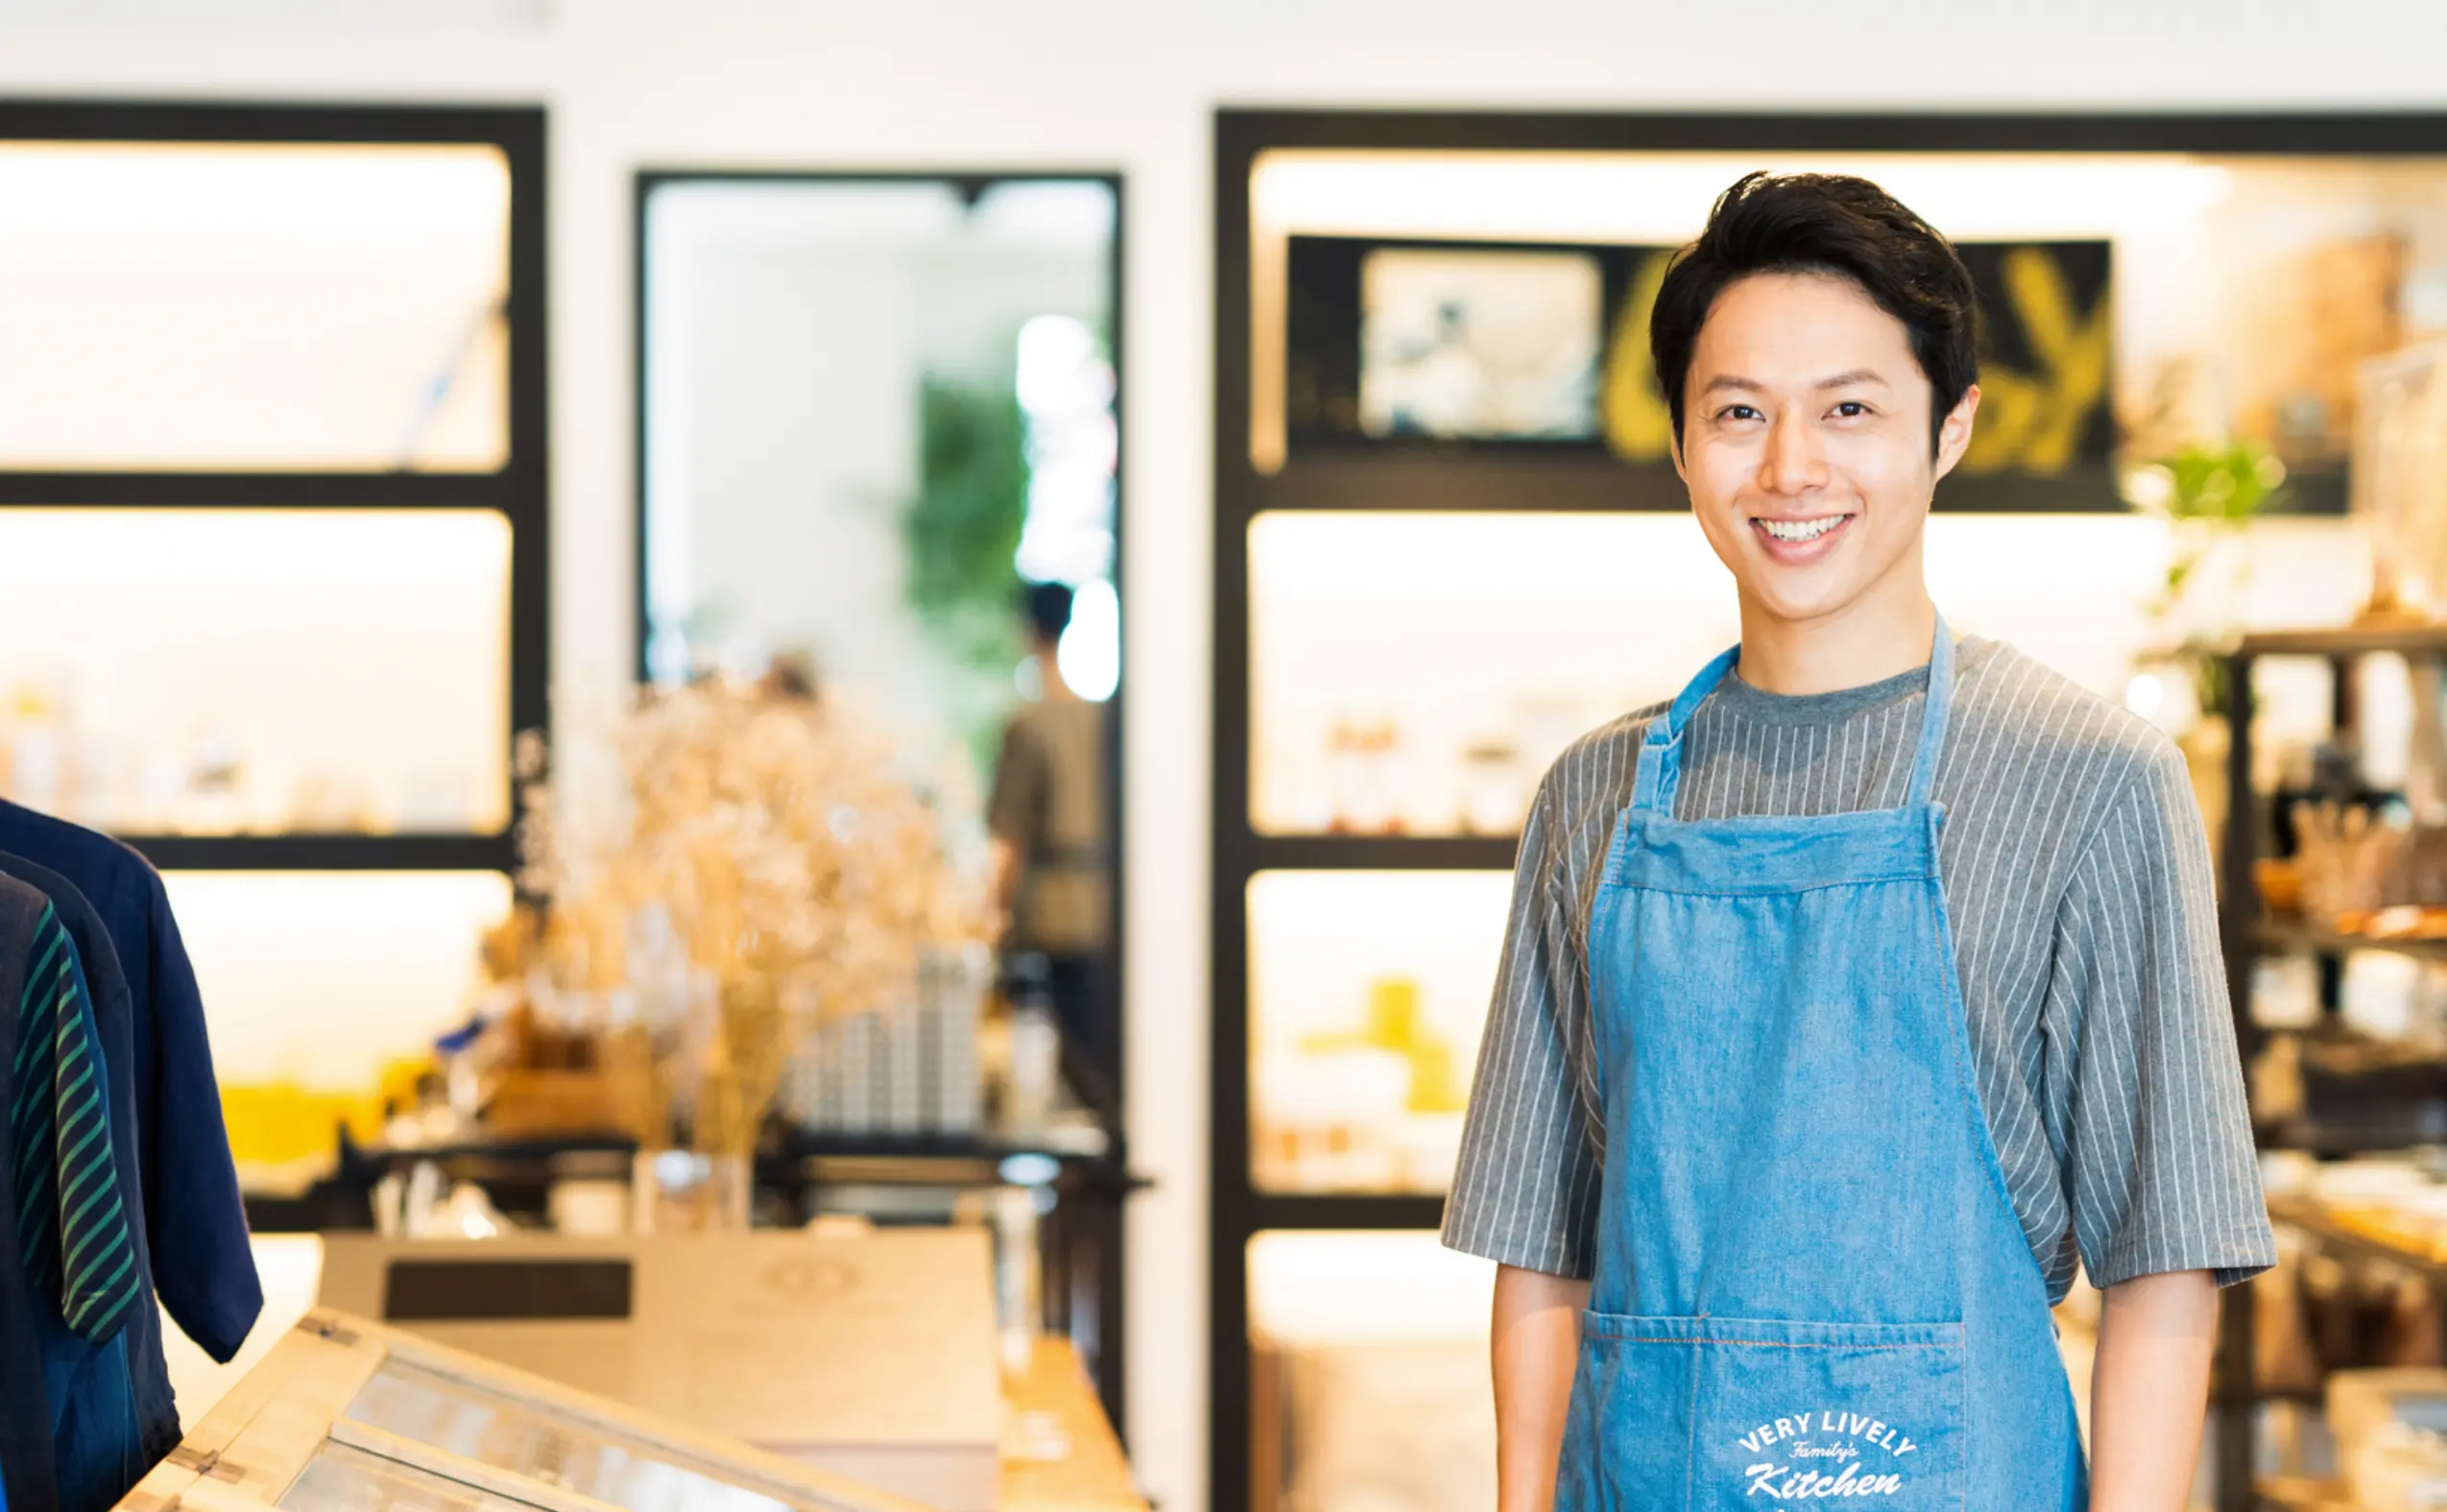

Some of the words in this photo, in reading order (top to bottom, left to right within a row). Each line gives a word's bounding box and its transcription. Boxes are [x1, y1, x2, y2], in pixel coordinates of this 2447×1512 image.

[1739, 1412, 1811, 1453] VERY
[1821, 1410, 1917, 1457] LIVELY
[1788, 1440, 1859, 1464] Family's
[1745, 1461, 1903, 1500] Kitchen
